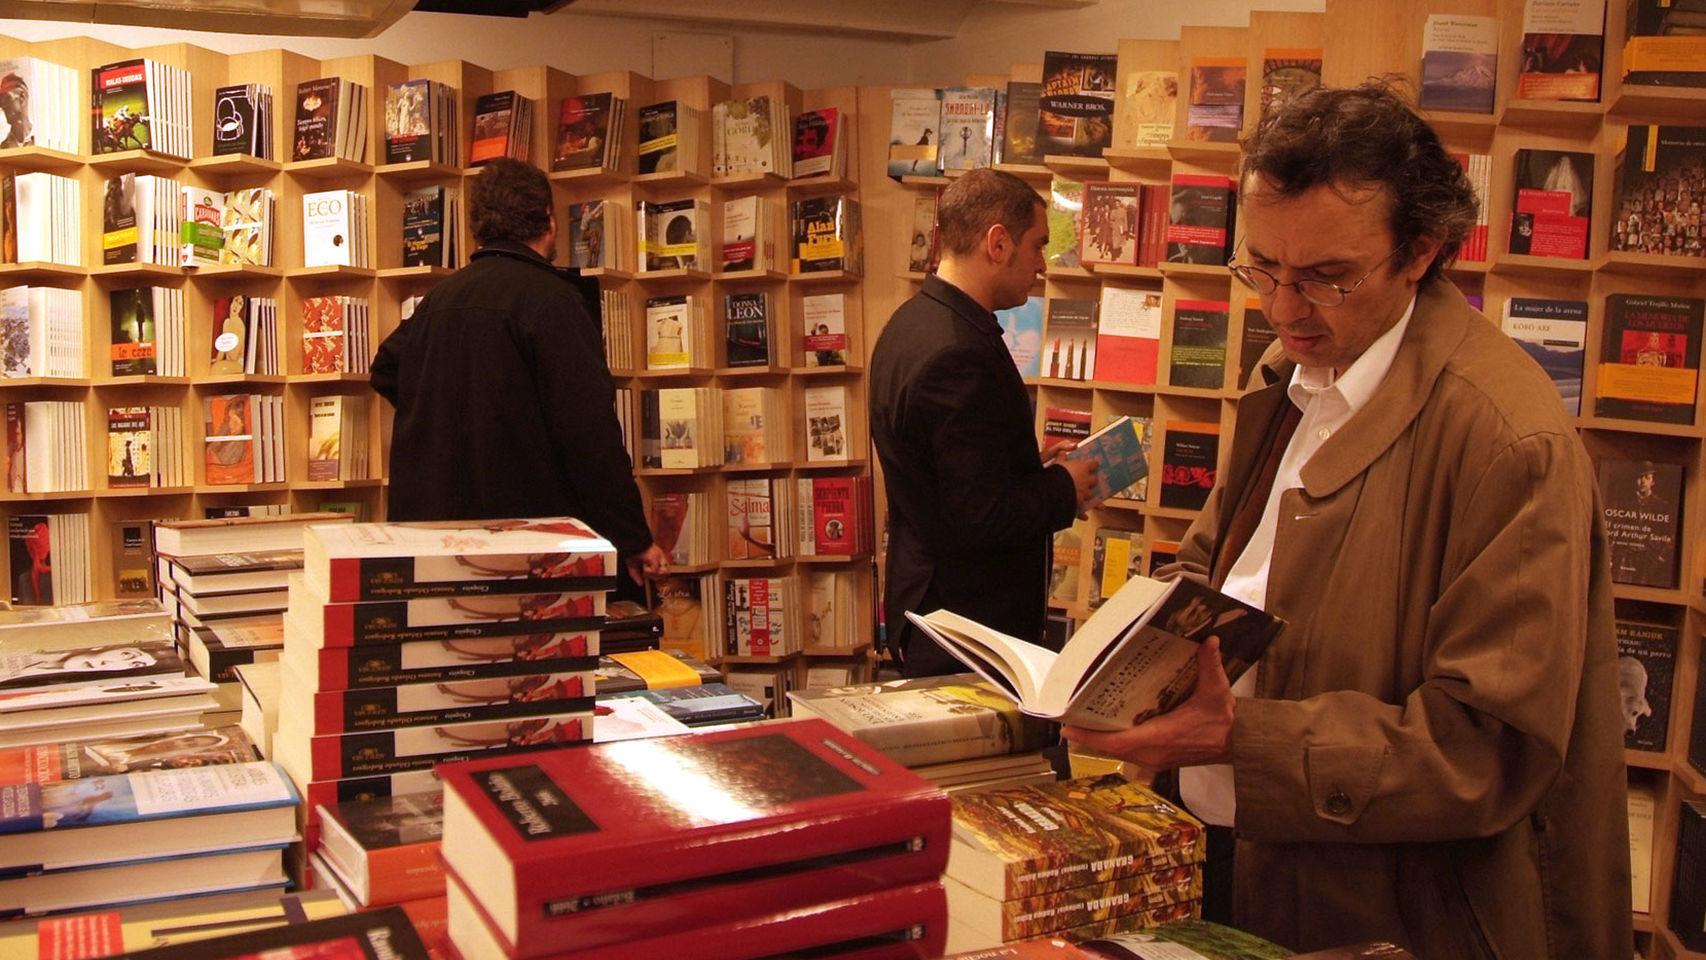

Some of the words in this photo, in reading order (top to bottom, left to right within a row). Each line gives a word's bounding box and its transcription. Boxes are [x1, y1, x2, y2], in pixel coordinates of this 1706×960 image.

[1050, 100, 1082, 111] WARNER
[307, 199, 342, 218] ECO
[807, 220, 834, 234] Alan
[732, 300, 758, 309] DONNA
[1514, 303, 1524, 311] La
[1525, 305, 1544, 315] mujer
[1545, 305, 1554, 313] de
[1555, 306, 1561, 314] la
[1626, 298, 1647, 307] Gabriel
[727, 305, 764, 321] LEON
[730, 497, 770, 516] Salma
[1604, 508, 1637, 520] OSCAR
[1639, 511, 1670, 523] WILDE
[1613, 522, 1640, 532] crimen
[1641, 525, 1651, 533] de
[1620, 530, 1648, 541] Arthur
[1650, 533, 1672, 543] Savile
[462, 584, 489, 592] Chiquita
[1626, 646, 1635, 655] de
[1650, 649, 1672, 659] perro
[1090, 854, 1134, 872] GRANADA
[1086, 892, 1130, 912] GRANADA
